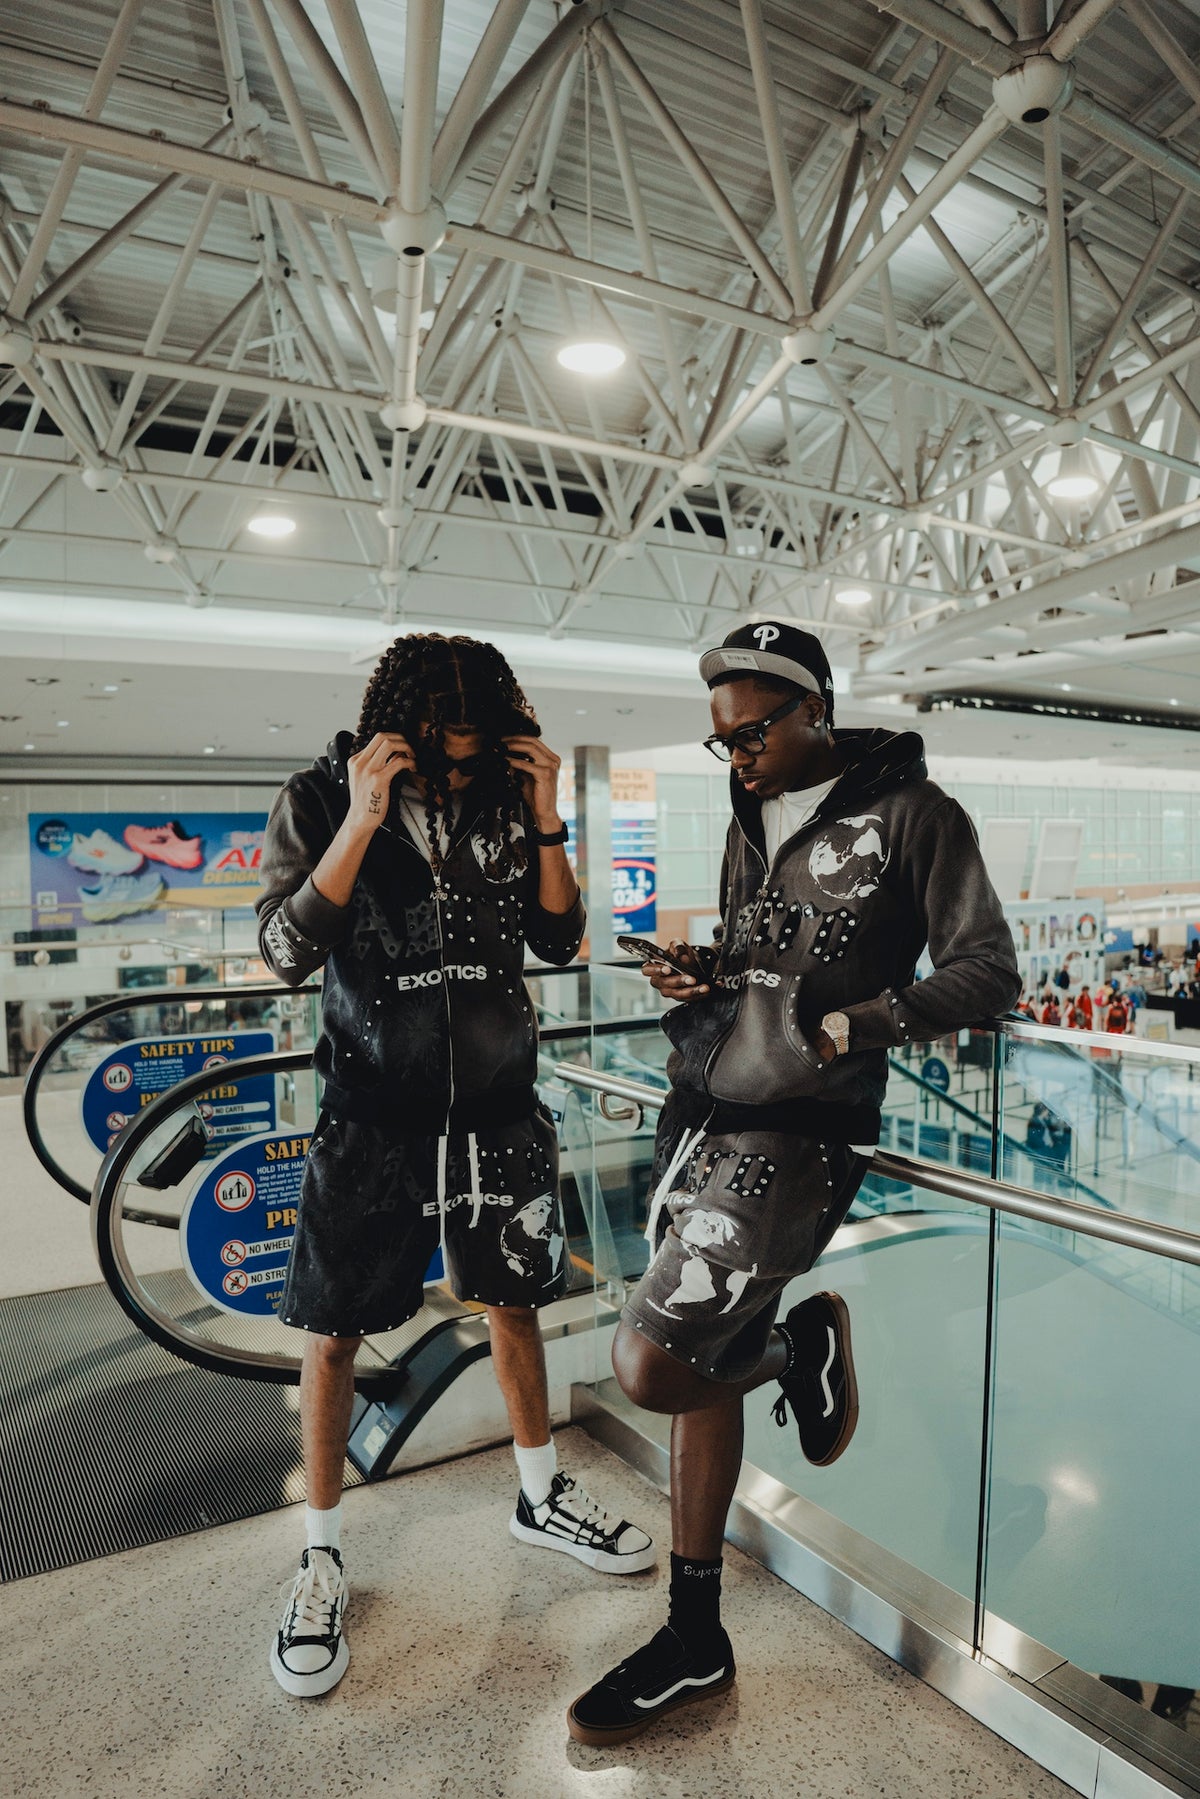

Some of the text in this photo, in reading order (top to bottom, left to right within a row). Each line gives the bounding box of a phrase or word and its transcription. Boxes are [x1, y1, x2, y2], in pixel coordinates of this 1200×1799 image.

[753, 624, 780, 650] P
[612, 888, 647, 908] 026
[397, 965, 488, 991] EXOTICS
[140, 1038, 235, 1058] SAFETY TIPS
[257, 1161, 305, 1175] HOLD THE HAN
[249, 1239, 291, 1254] NO WHEEL
[251, 1269, 287, 1283] NO STRO
